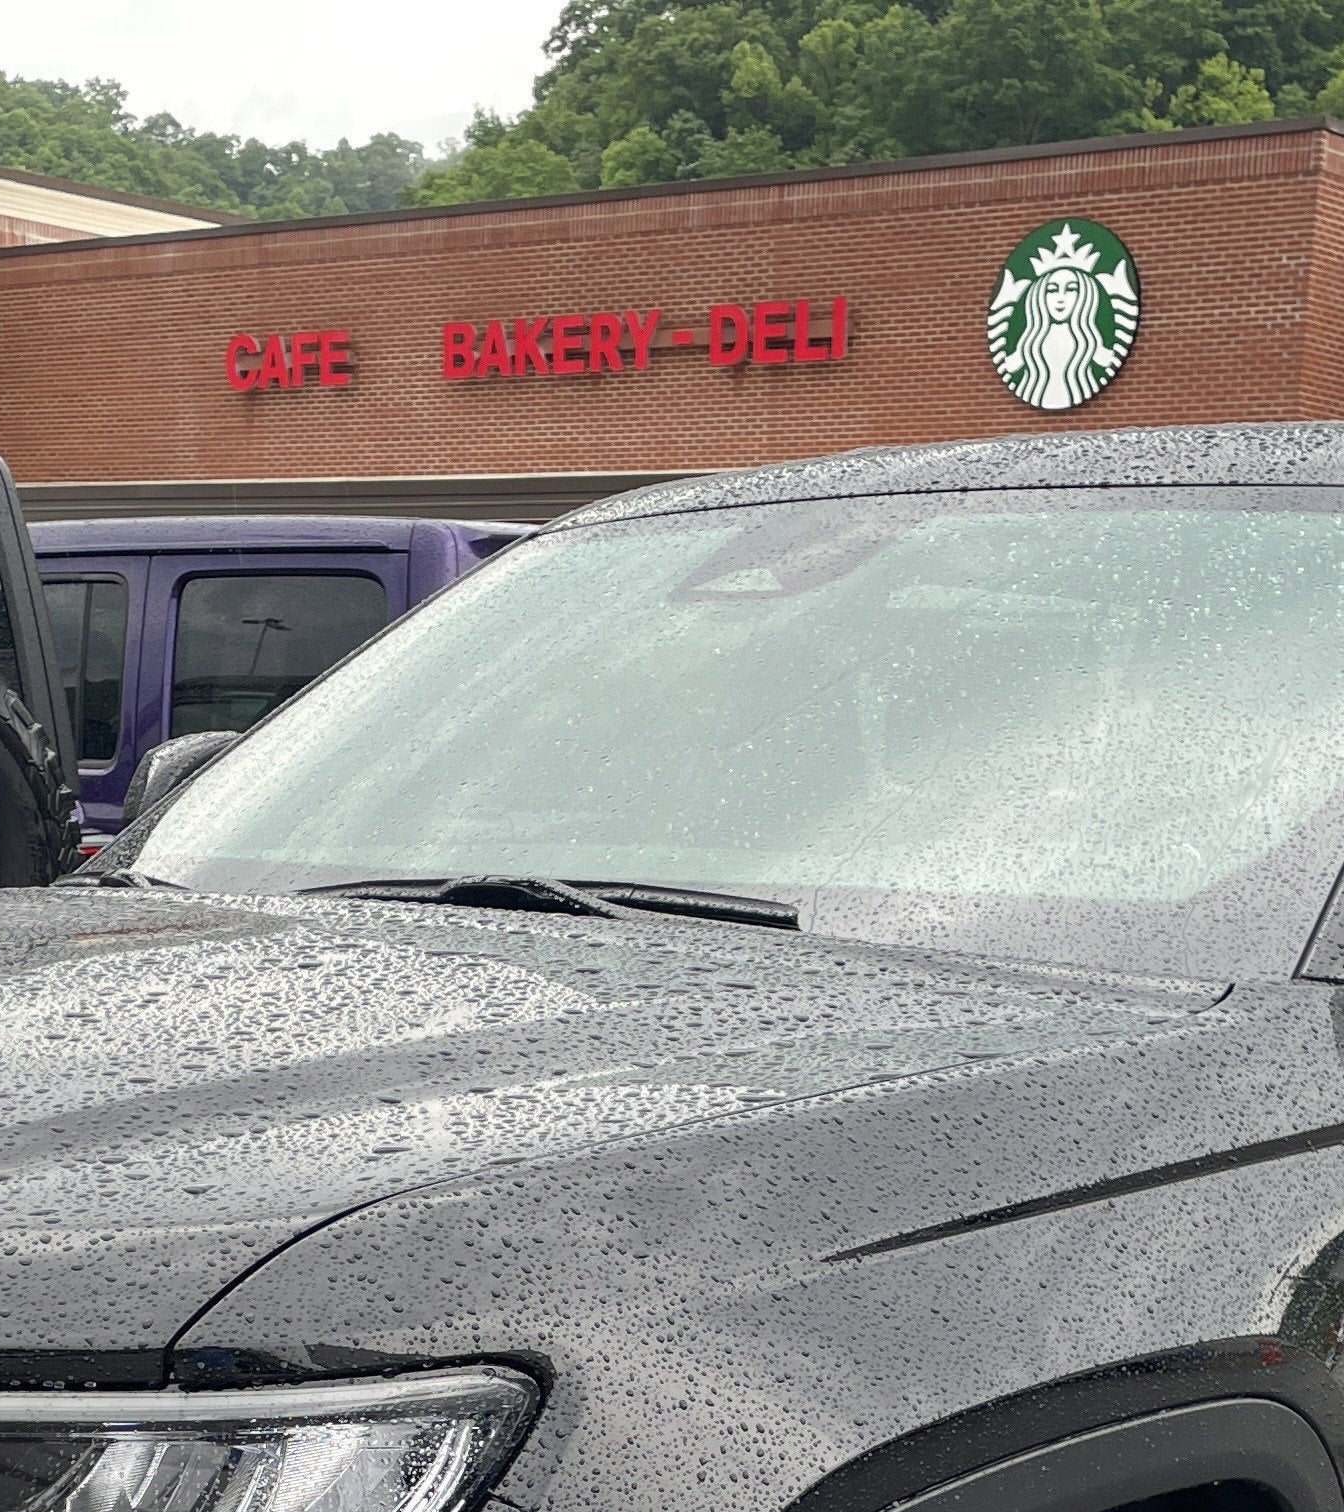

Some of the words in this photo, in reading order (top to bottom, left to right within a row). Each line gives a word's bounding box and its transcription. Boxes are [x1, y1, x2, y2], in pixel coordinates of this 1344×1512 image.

[225, 330, 349, 390] CAFE
[442, 309, 661, 379] BAKERY
[709, 296, 848, 366] DELI
